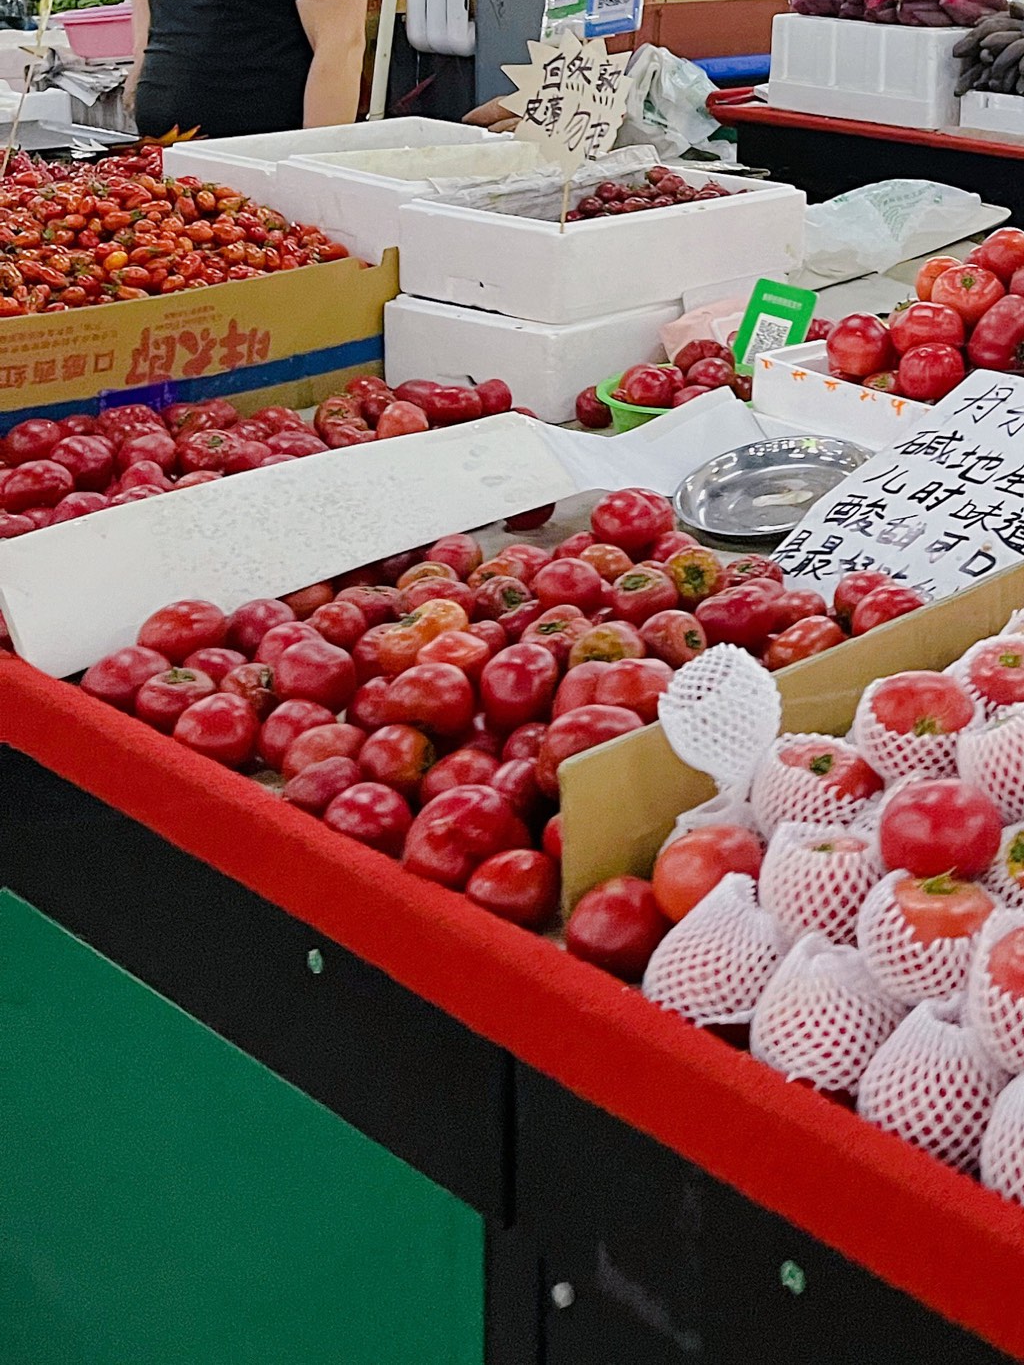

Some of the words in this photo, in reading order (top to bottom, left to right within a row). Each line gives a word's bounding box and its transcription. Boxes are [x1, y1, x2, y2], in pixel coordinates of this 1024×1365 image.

[542, 51, 622, 109] 自然熟
[823, 492, 998, 578] 酸甜可口
